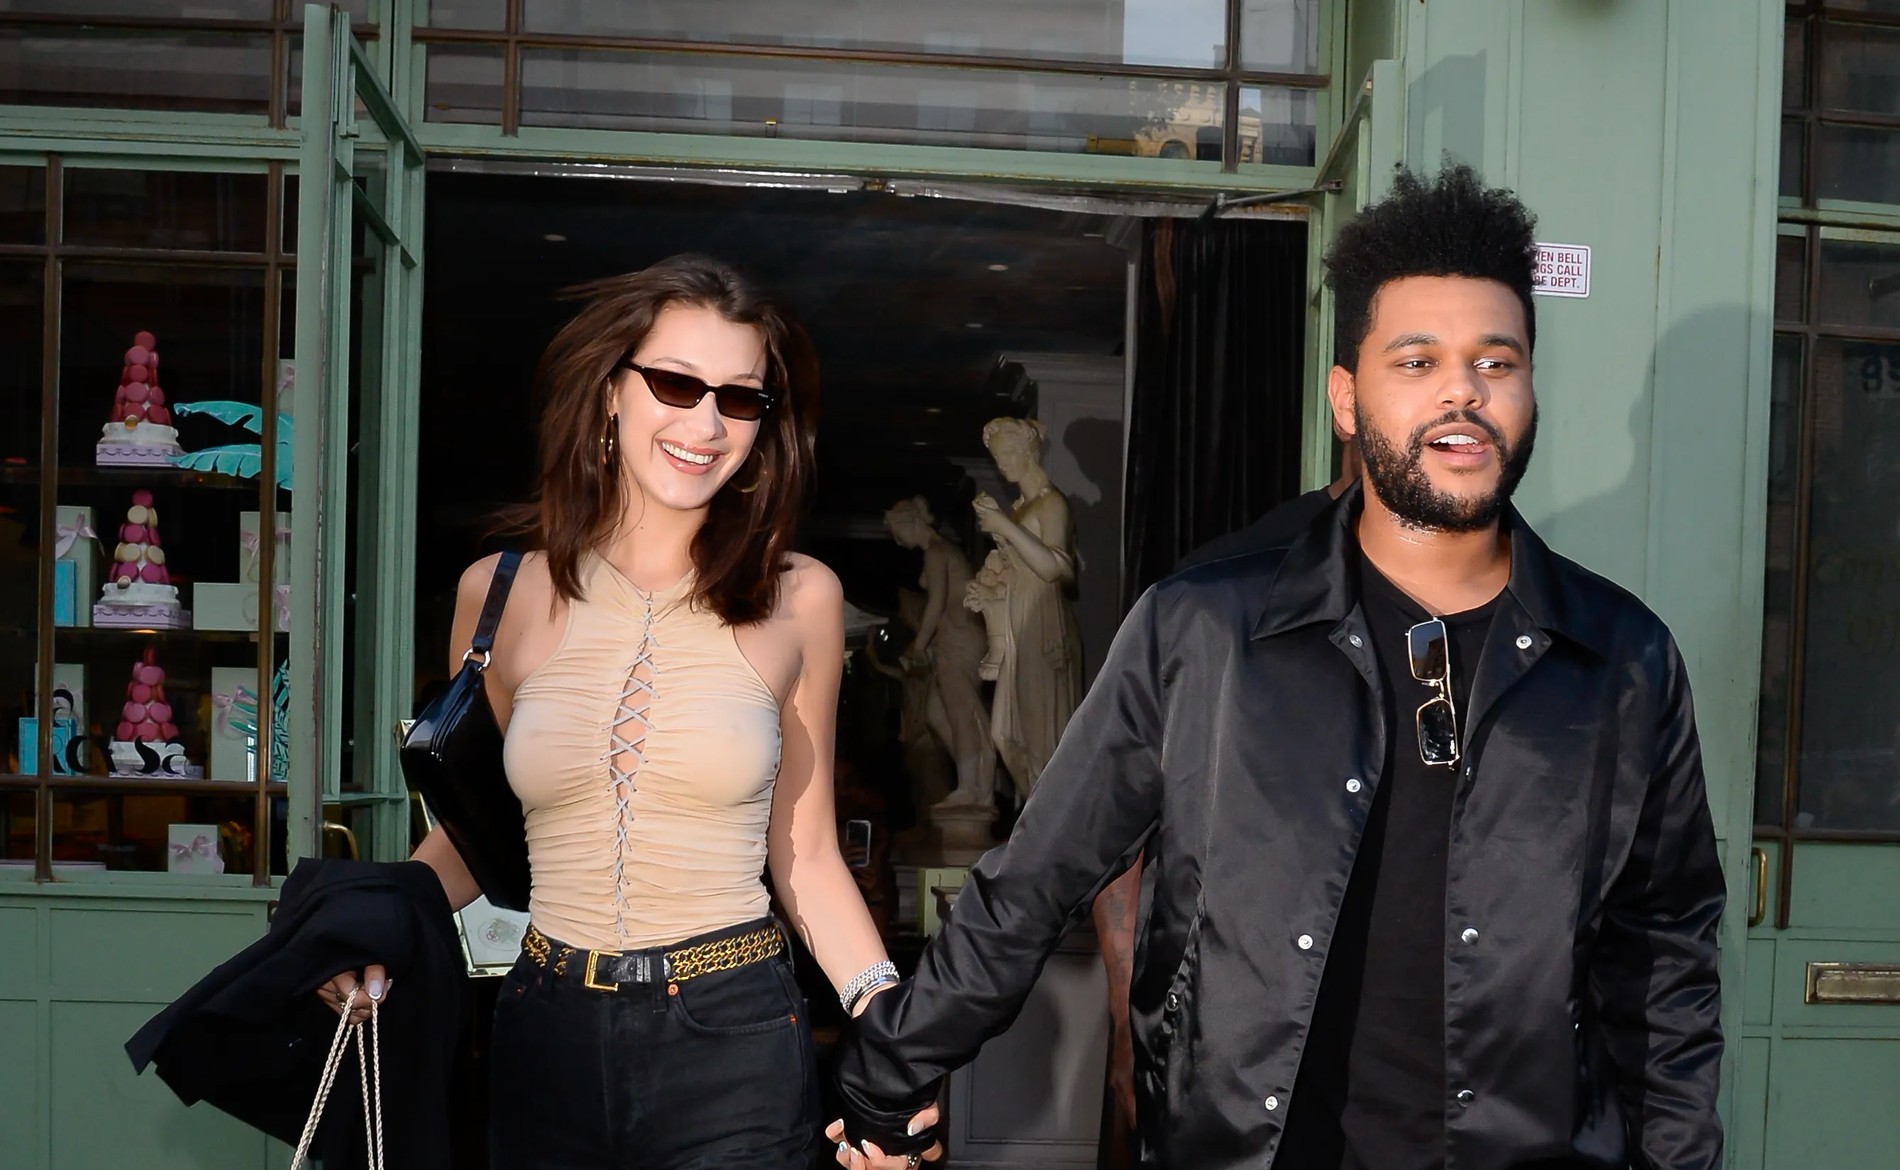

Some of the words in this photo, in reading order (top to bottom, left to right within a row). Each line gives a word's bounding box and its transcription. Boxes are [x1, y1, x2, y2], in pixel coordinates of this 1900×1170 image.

[1536, 250, 1554, 262] EN
[1557, 252, 1583, 265] BELL
[1536, 263, 1553, 275] GS
[1557, 264, 1583, 277] CALL
[1550, 276, 1580, 289] DEPT.
